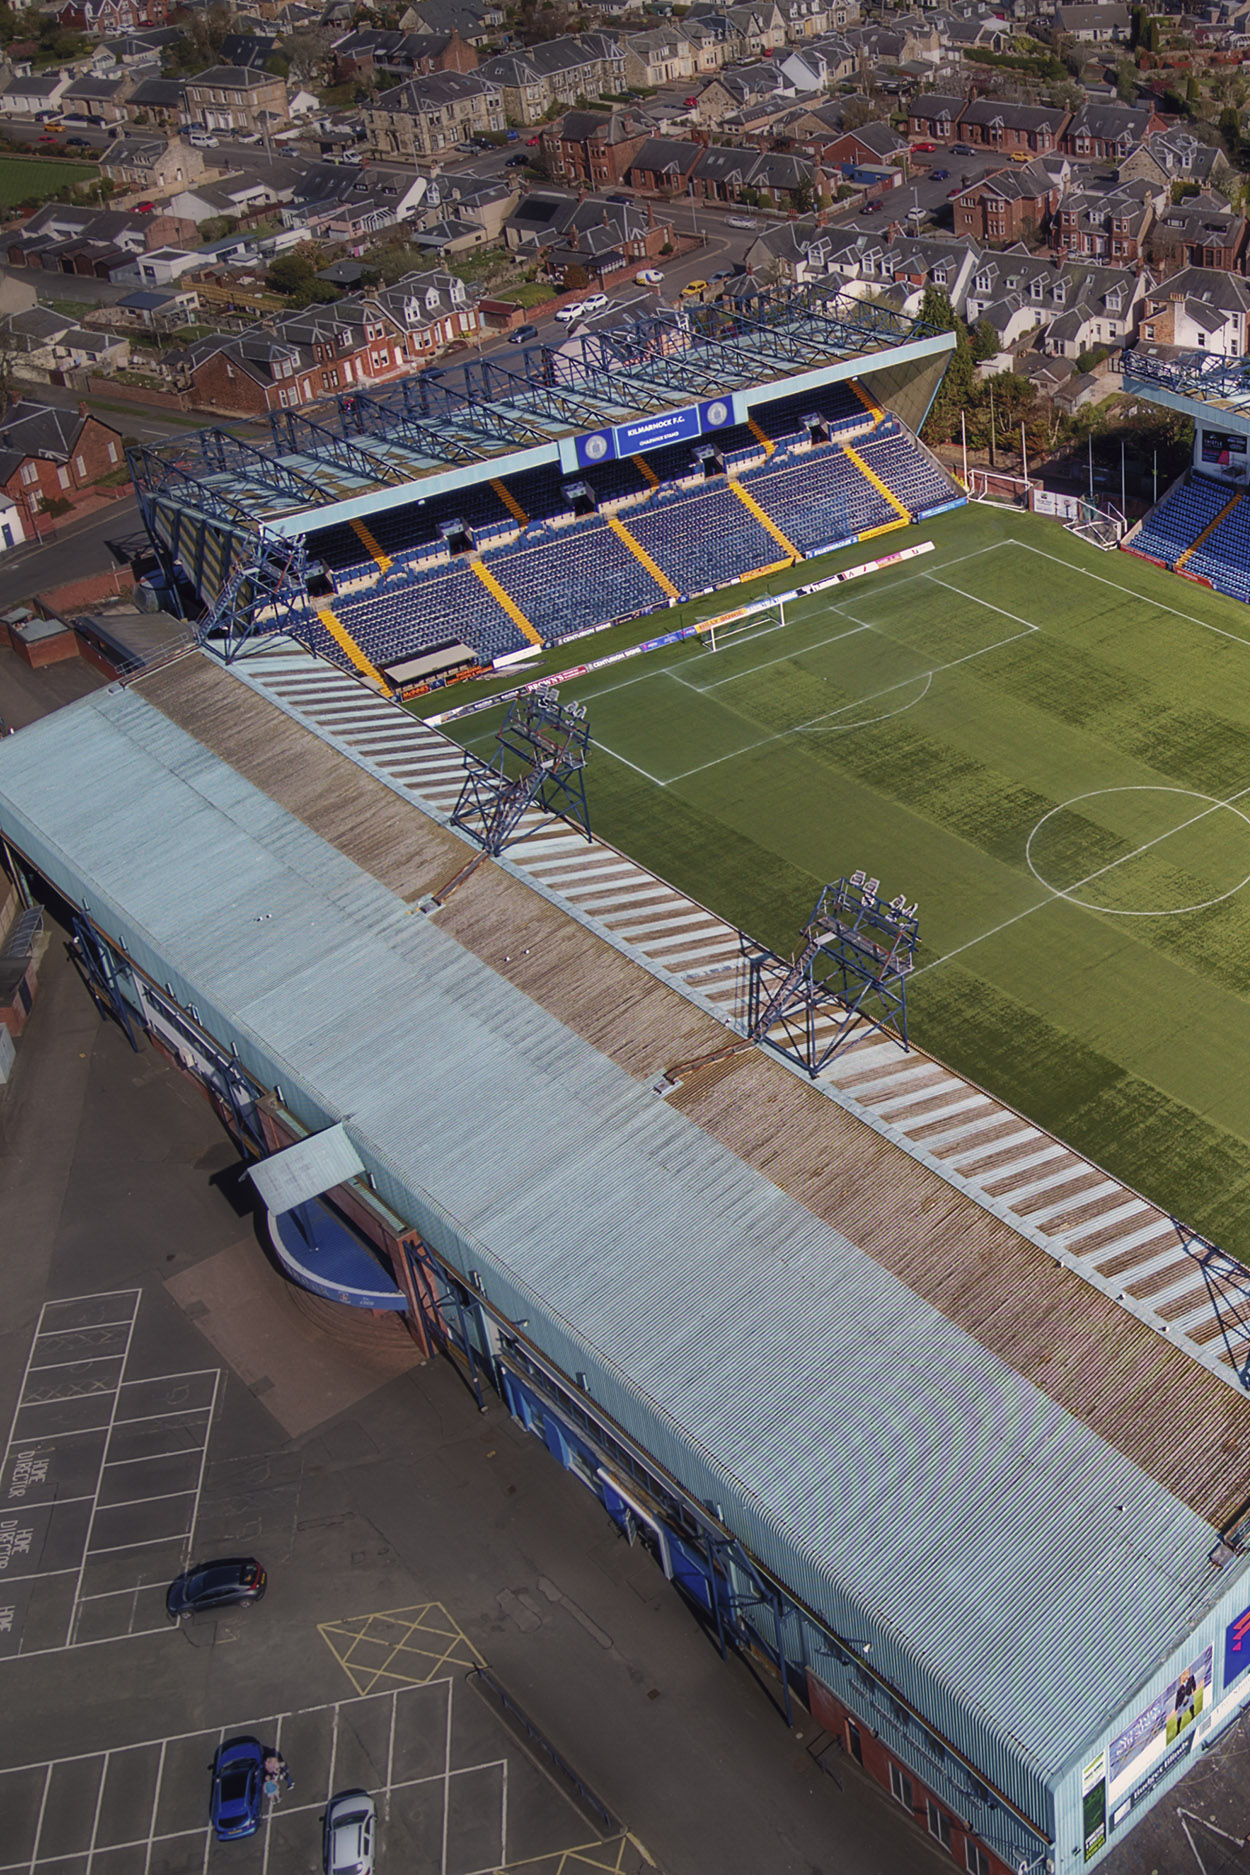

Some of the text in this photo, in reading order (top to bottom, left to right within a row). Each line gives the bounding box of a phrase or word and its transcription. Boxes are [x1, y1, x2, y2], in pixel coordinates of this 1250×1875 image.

[627, 416, 685, 437] KILMARNOCK F.C.
[563, 621, 612, 643] CENTURION SIGNS
[593, 647, 641, 668] CENTURION SIGNS
[527, 674, 564, 692] BROWN'S
[8, 1450, 36, 1498] DIRECTOR
[28, 1458, 50, 1484] HOME
[11, 1528, 34, 1556] HOME
[1133, 1766, 1163, 1799] Budget
[1164, 1740, 1190, 1768] Blinds
